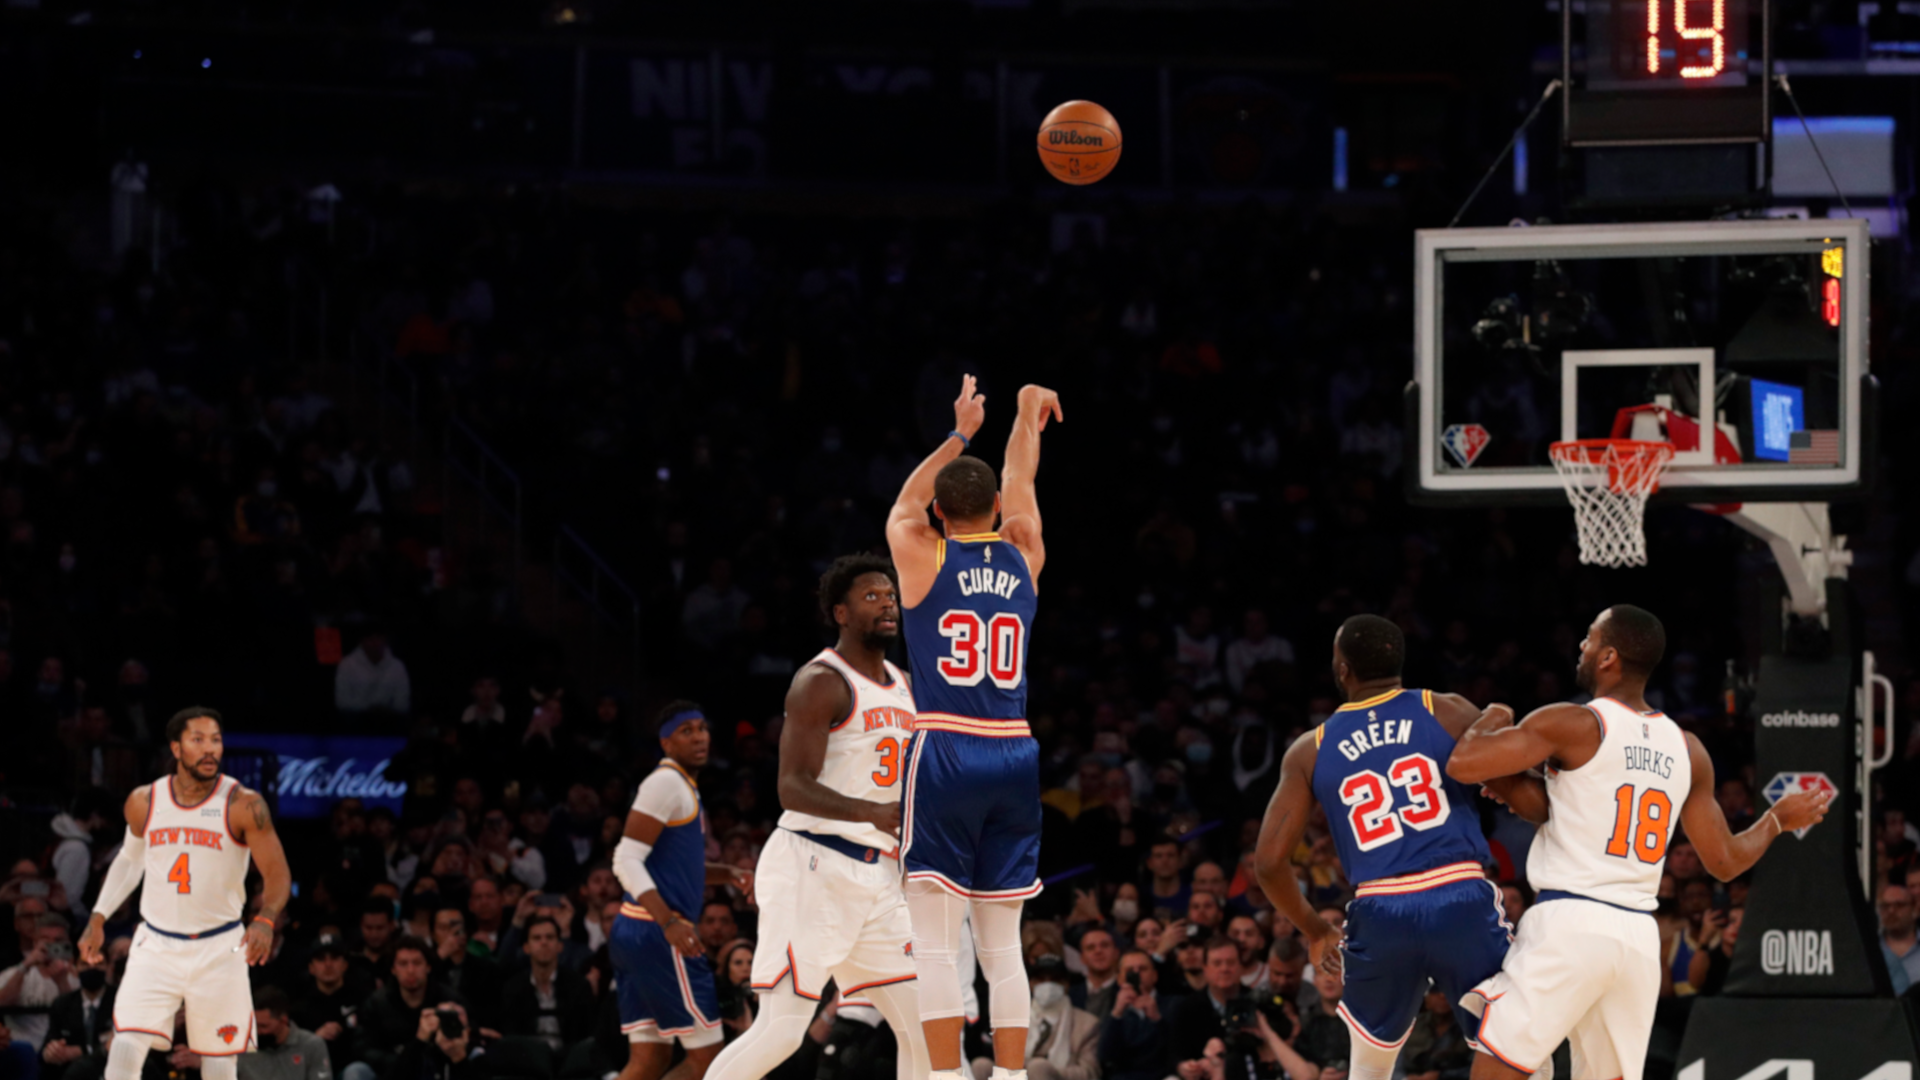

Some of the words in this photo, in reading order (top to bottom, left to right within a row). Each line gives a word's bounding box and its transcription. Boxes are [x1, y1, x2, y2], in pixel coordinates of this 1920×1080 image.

[1647, 0, 1724, 78] 19
[1049, 130, 1103, 147] Wilson
[957, 568, 1021, 600] CURRY
[937, 609, 1025, 690] 30
[863, 706, 893, 732] NEW
[1761, 710, 1840, 727] coinbase
[1338, 719, 1412, 761] GREEN
[1624, 746, 1674, 780] BURKS
[1338, 752, 1451, 852] 23
[149, 827, 181, 847] NEW
[182, 828, 223, 851] YORK
[1605, 783, 1672, 865] 18
[168, 853, 191, 894] 4
[1761, 930, 1834, 975] @NBA
